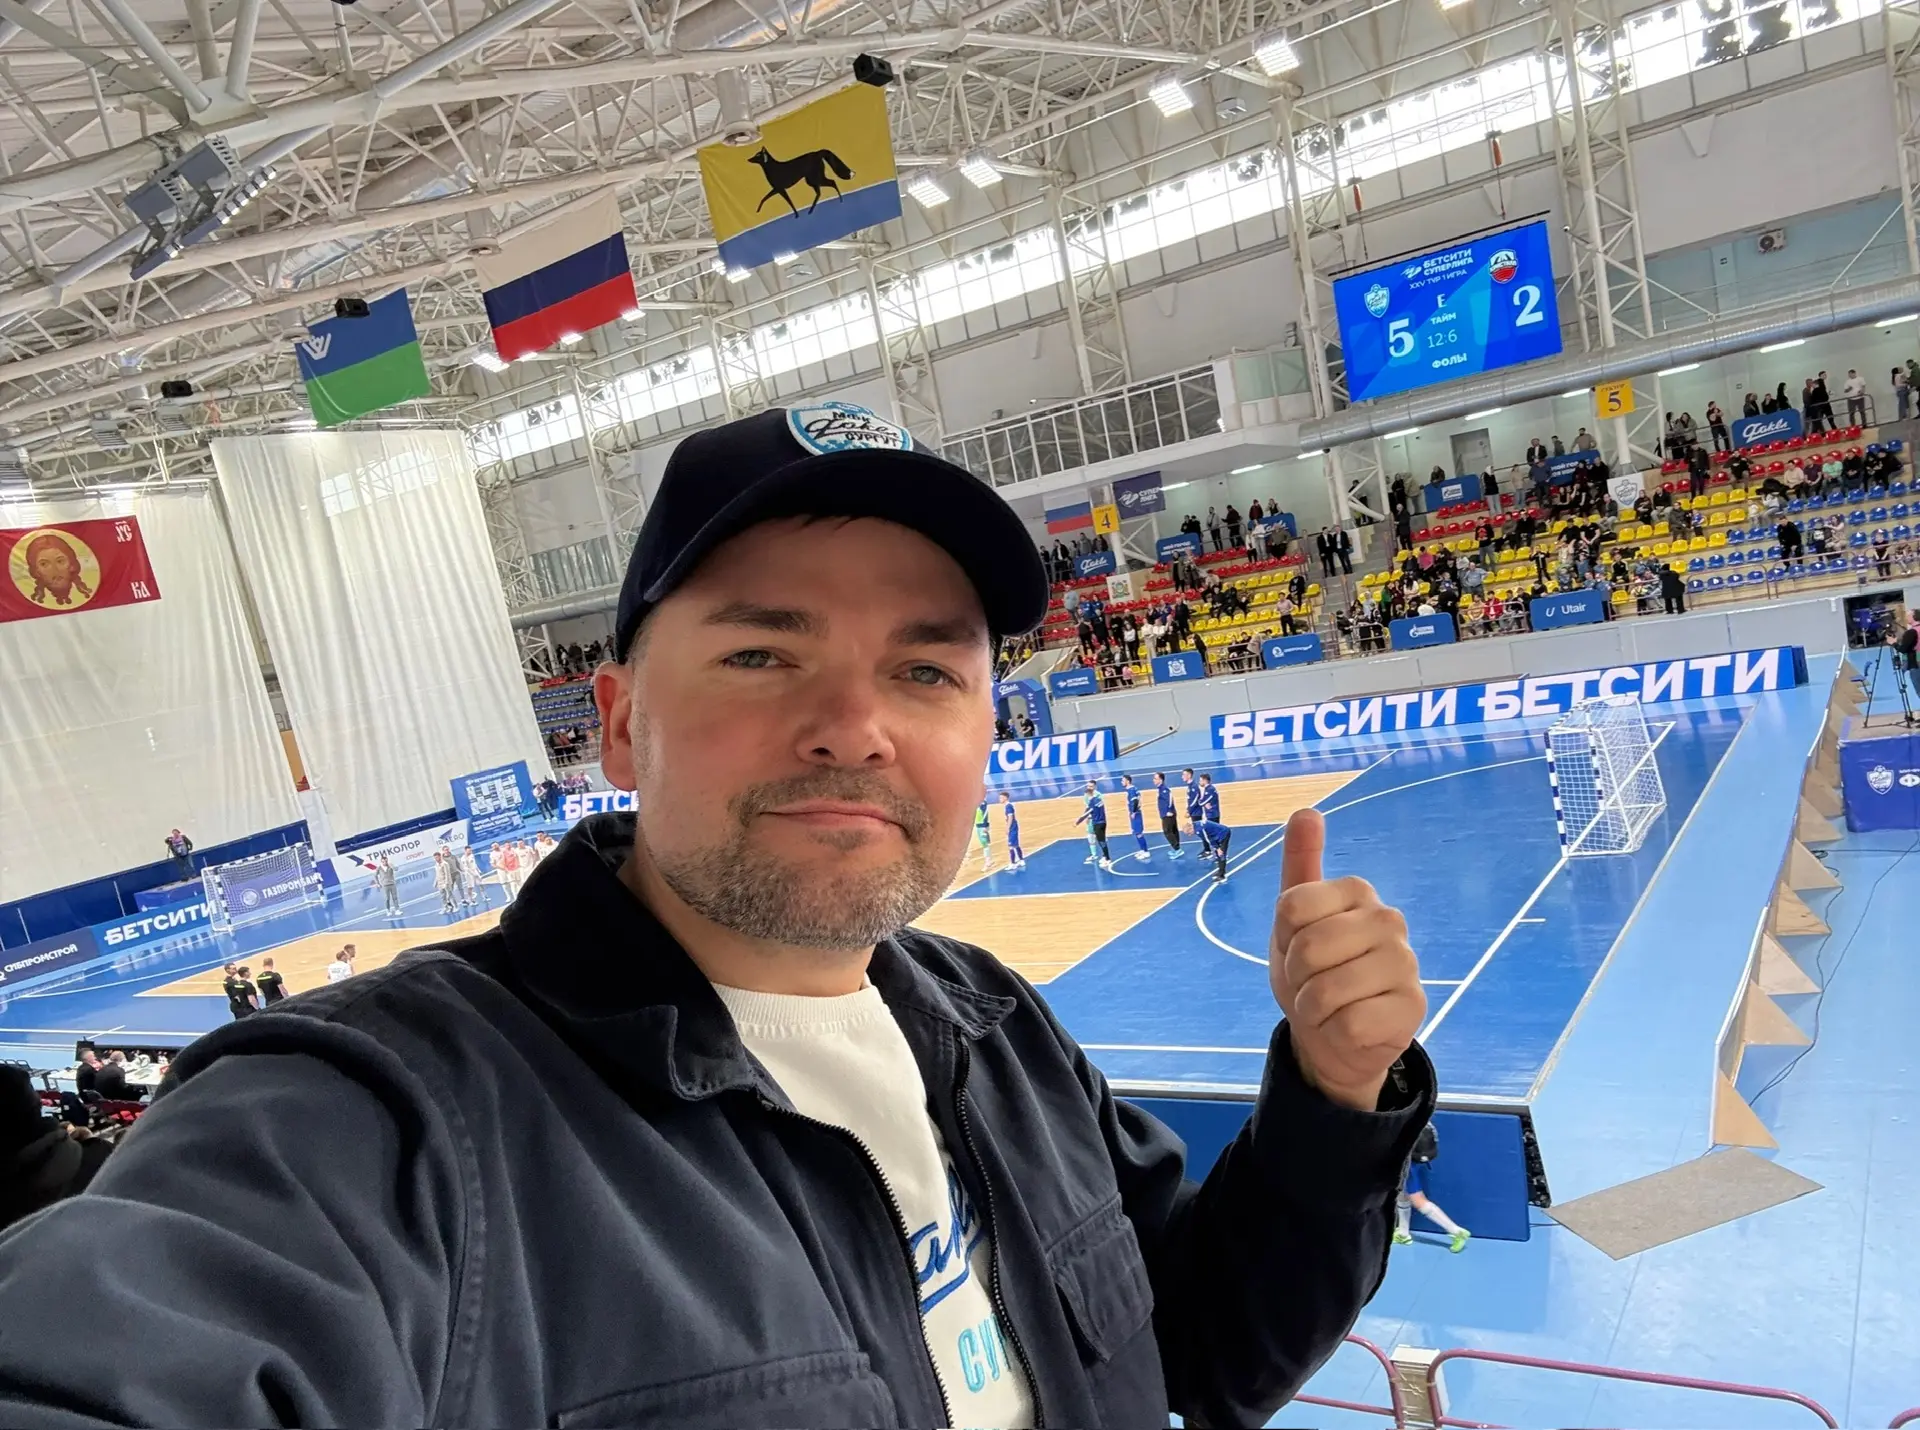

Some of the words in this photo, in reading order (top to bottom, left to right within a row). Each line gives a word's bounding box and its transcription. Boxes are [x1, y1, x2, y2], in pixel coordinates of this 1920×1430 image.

[1423, 248, 1472, 268] БЕТСИТИ
[1424, 257, 1473, 275] СУПЕРЛИГА
[1447, 269, 1467, 279] ИГРА
[1512, 284, 1544, 327] 2
[1430, 312, 1456, 325] ТАЙМ
[1388, 318, 1414, 358] 5
[1427, 329, 1458, 348] 12:6
[1432, 352, 1467, 369] ФОЛЫ
[1608, 391, 1622, 412] 5
[1101, 513, 1111, 528] 4
[1561, 602, 1587, 615] Utair
[1477, 648, 1780, 721] БЕТСИТИ
[1219, 688, 1458, 749] БЕТСИТИ
[984, 731, 1105, 774] СИТИ
[562, 789, 640, 821] БЕТС
[366, 839, 421, 861] ТРИКОЛОР
[104, 901, 218, 946] БЕТСИТИ
[3, 943, 78, 972] СИБПРОМСТРОЙ
